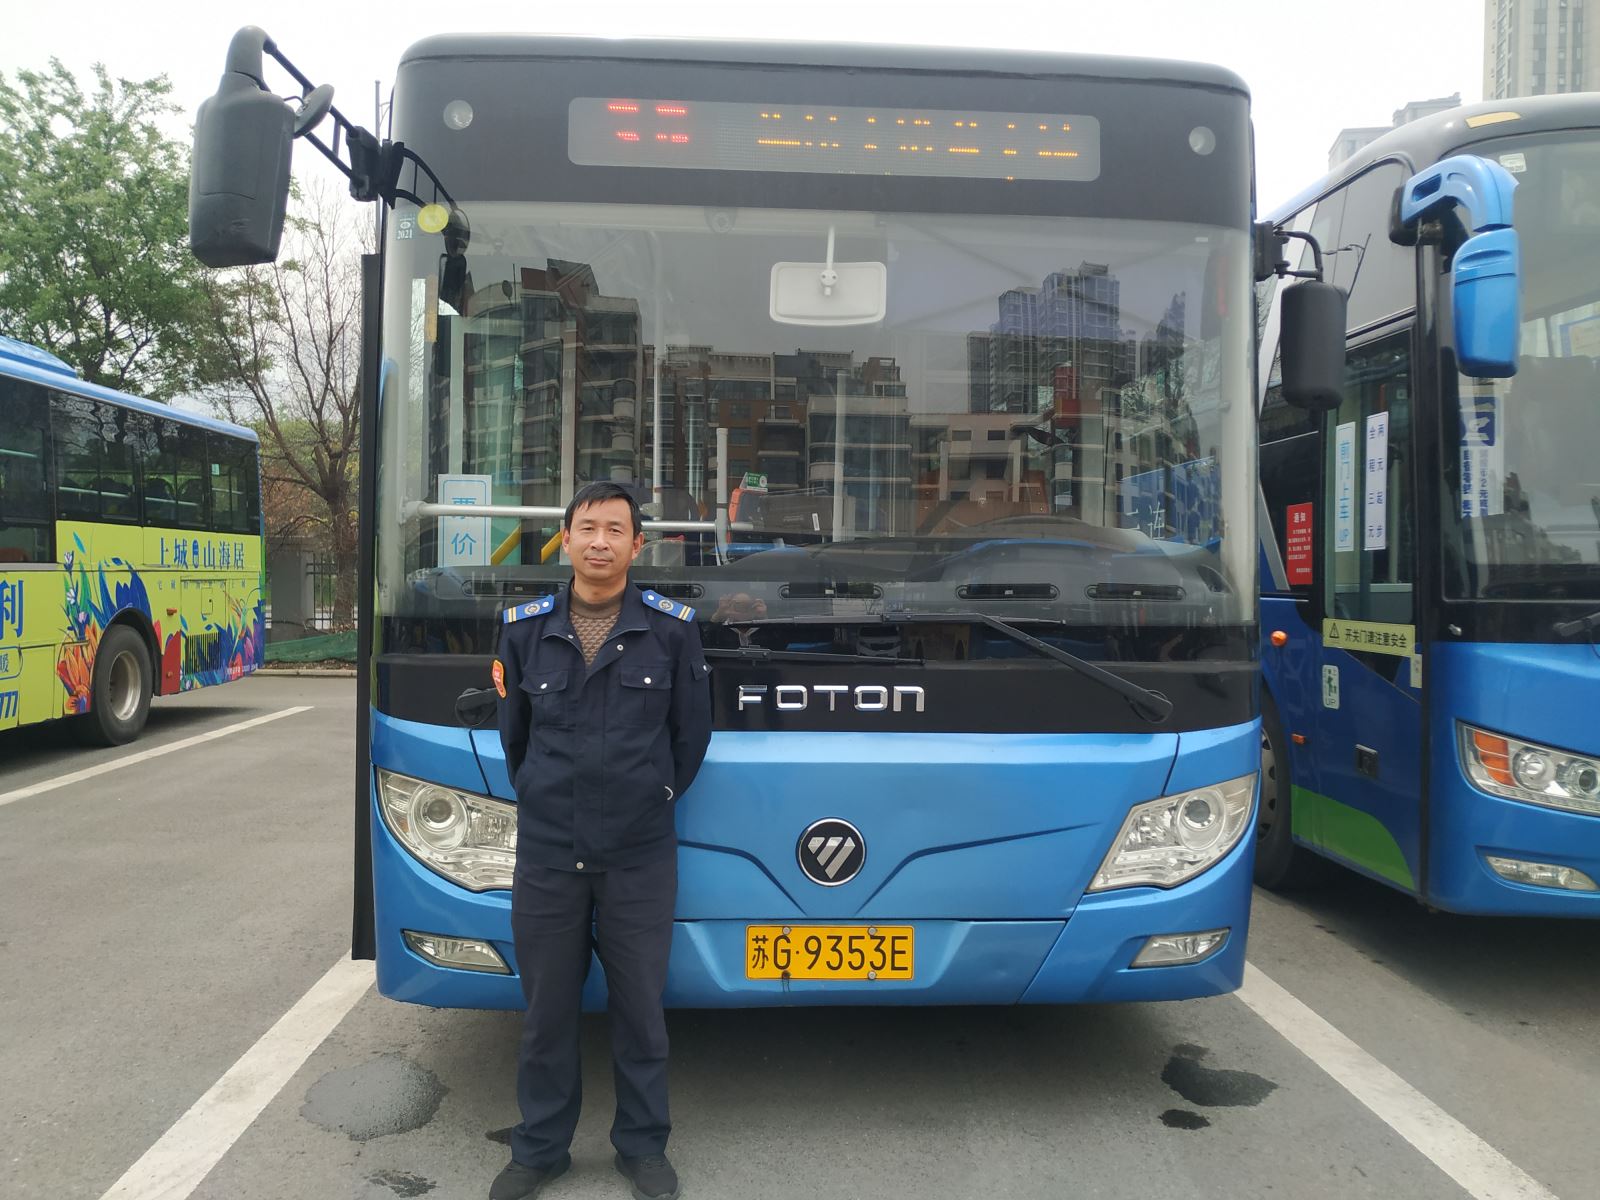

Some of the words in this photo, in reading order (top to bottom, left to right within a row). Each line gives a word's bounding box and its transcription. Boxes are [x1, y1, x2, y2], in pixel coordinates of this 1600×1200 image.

[396, 229, 413, 239] 2021
[160, 537, 188, 569] 上城
[203, 540, 245, 570] 山海居
[1345, 628, 1407, 648] 开关门请注意安全
[738, 684, 925, 712] FOTON
